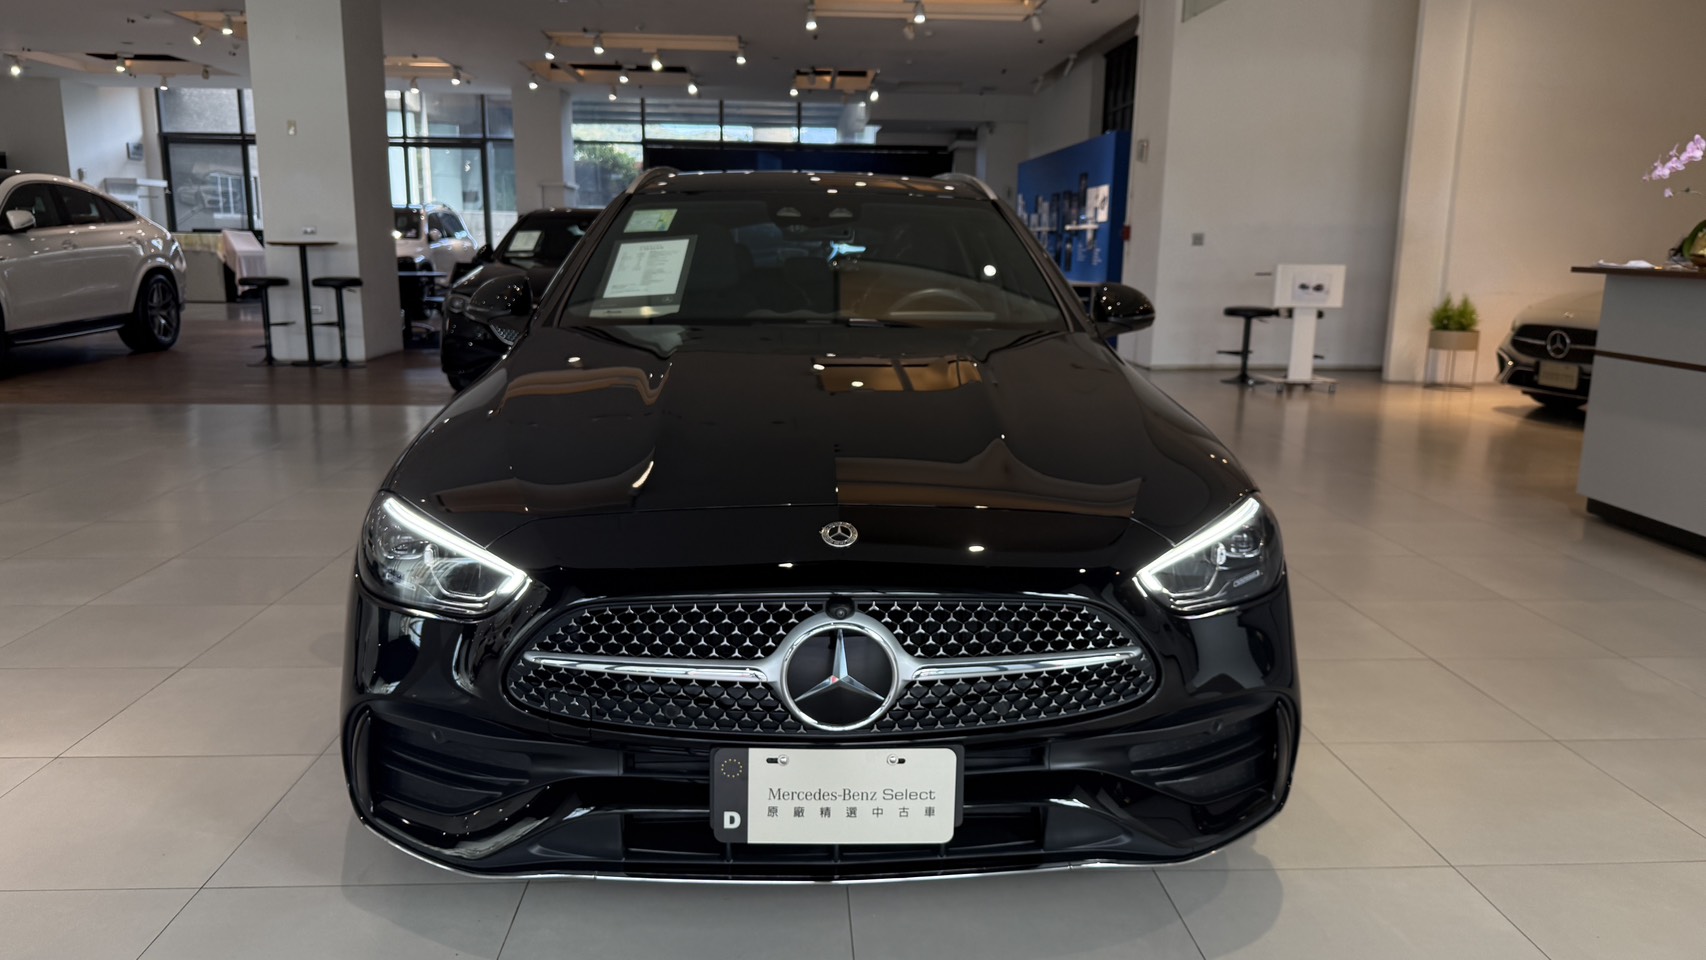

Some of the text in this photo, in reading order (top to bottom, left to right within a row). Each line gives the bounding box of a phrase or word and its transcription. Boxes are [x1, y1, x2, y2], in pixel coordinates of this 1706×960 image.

[768, 788, 936, 801] Mercedes-Benz Select
[723, 811, 741, 829] D
